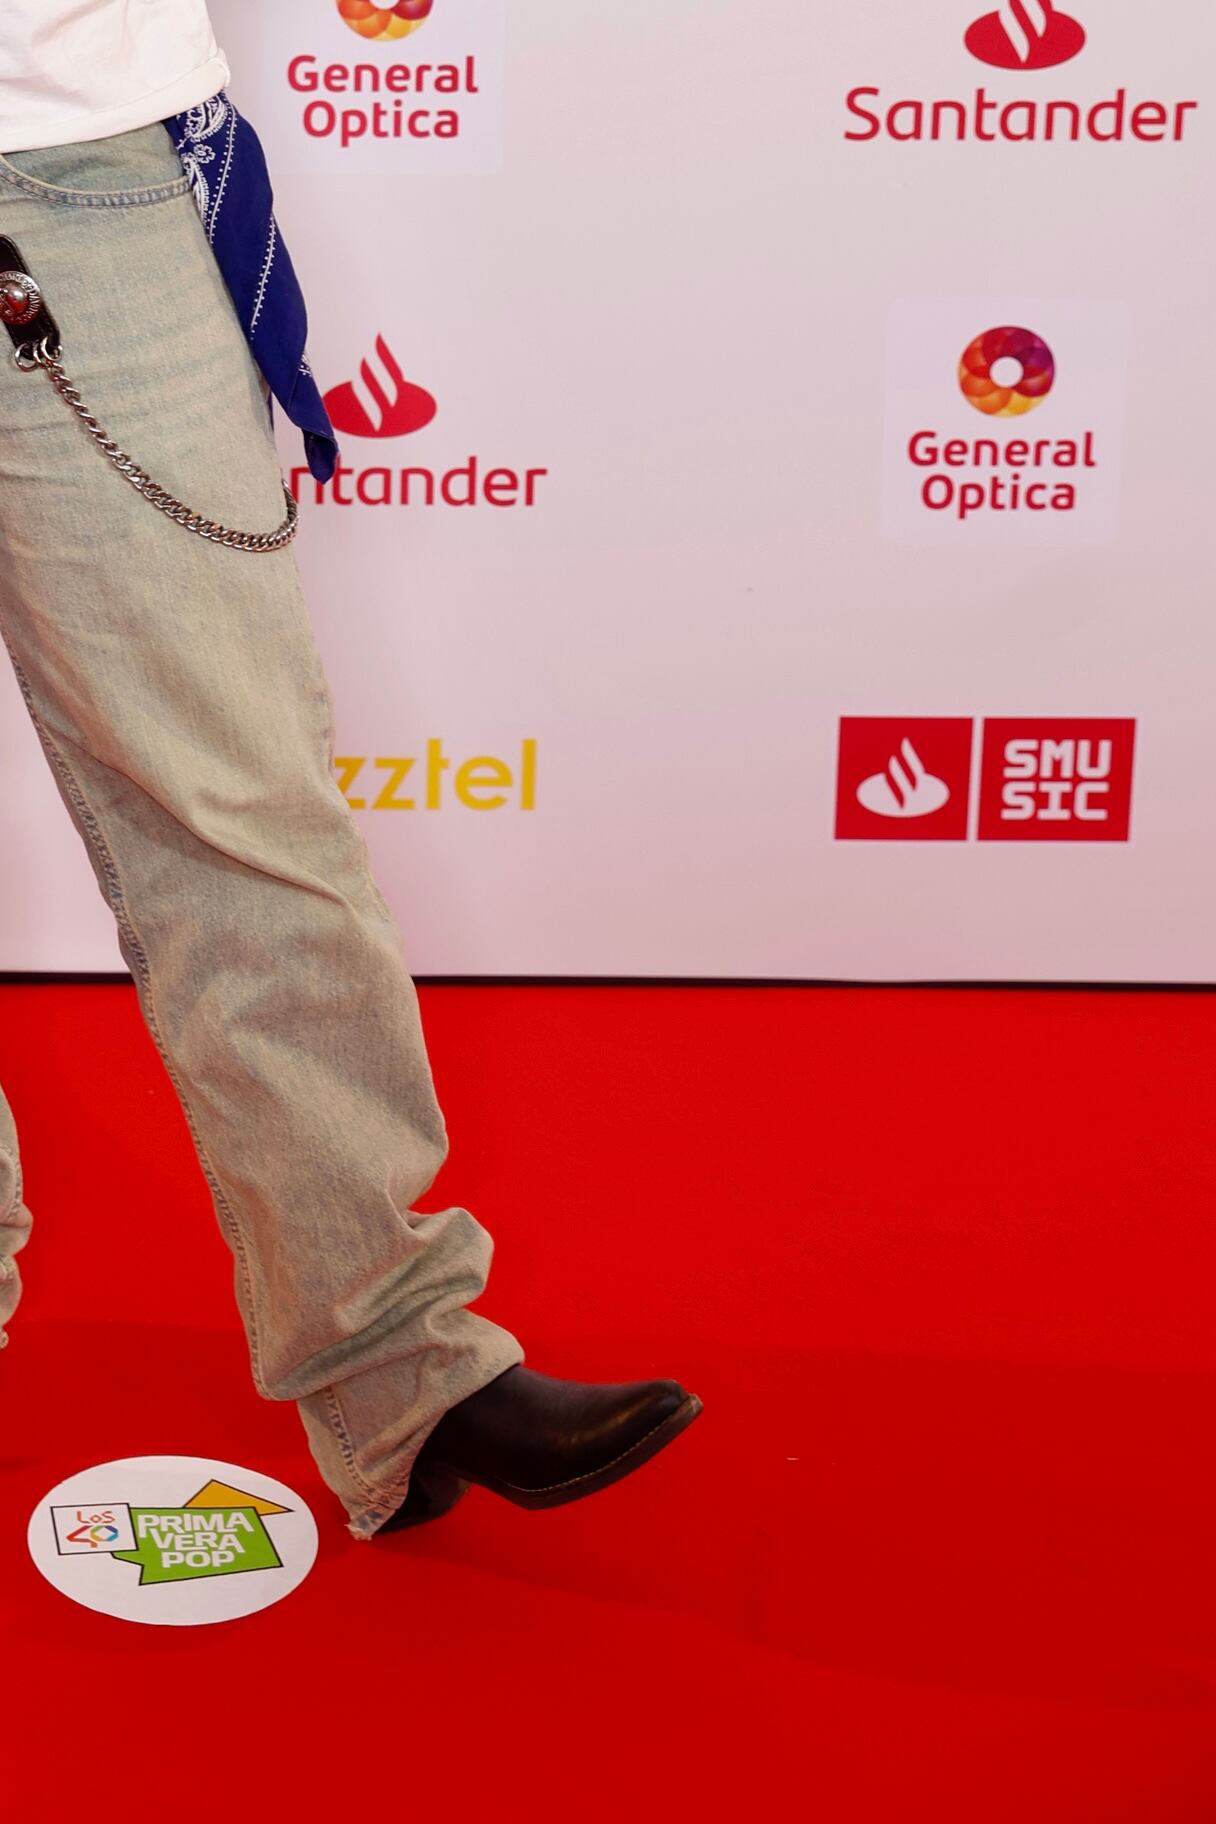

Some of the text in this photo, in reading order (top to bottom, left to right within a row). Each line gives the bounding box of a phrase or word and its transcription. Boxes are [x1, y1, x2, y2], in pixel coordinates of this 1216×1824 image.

[288, 55, 480, 94] General
[304, 99, 460, 149] Optica
[845, 87, 1199, 143] Santander
[908, 431, 1097, 469] General
[283, 456, 548, 507] ntander
[922, 474, 1077, 521] Optica
[334, 738, 538, 811] zztel
[1004, 740, 1113, 779] SMU
[1002, 780, 1110, 821] SIC
[66, 1525, 119, 1547] 40
[137, 1512, 254, 1538] PRIMA
[150, 1528, 245, 1553] VERA
[161, 1551, 235, 1568] POP
